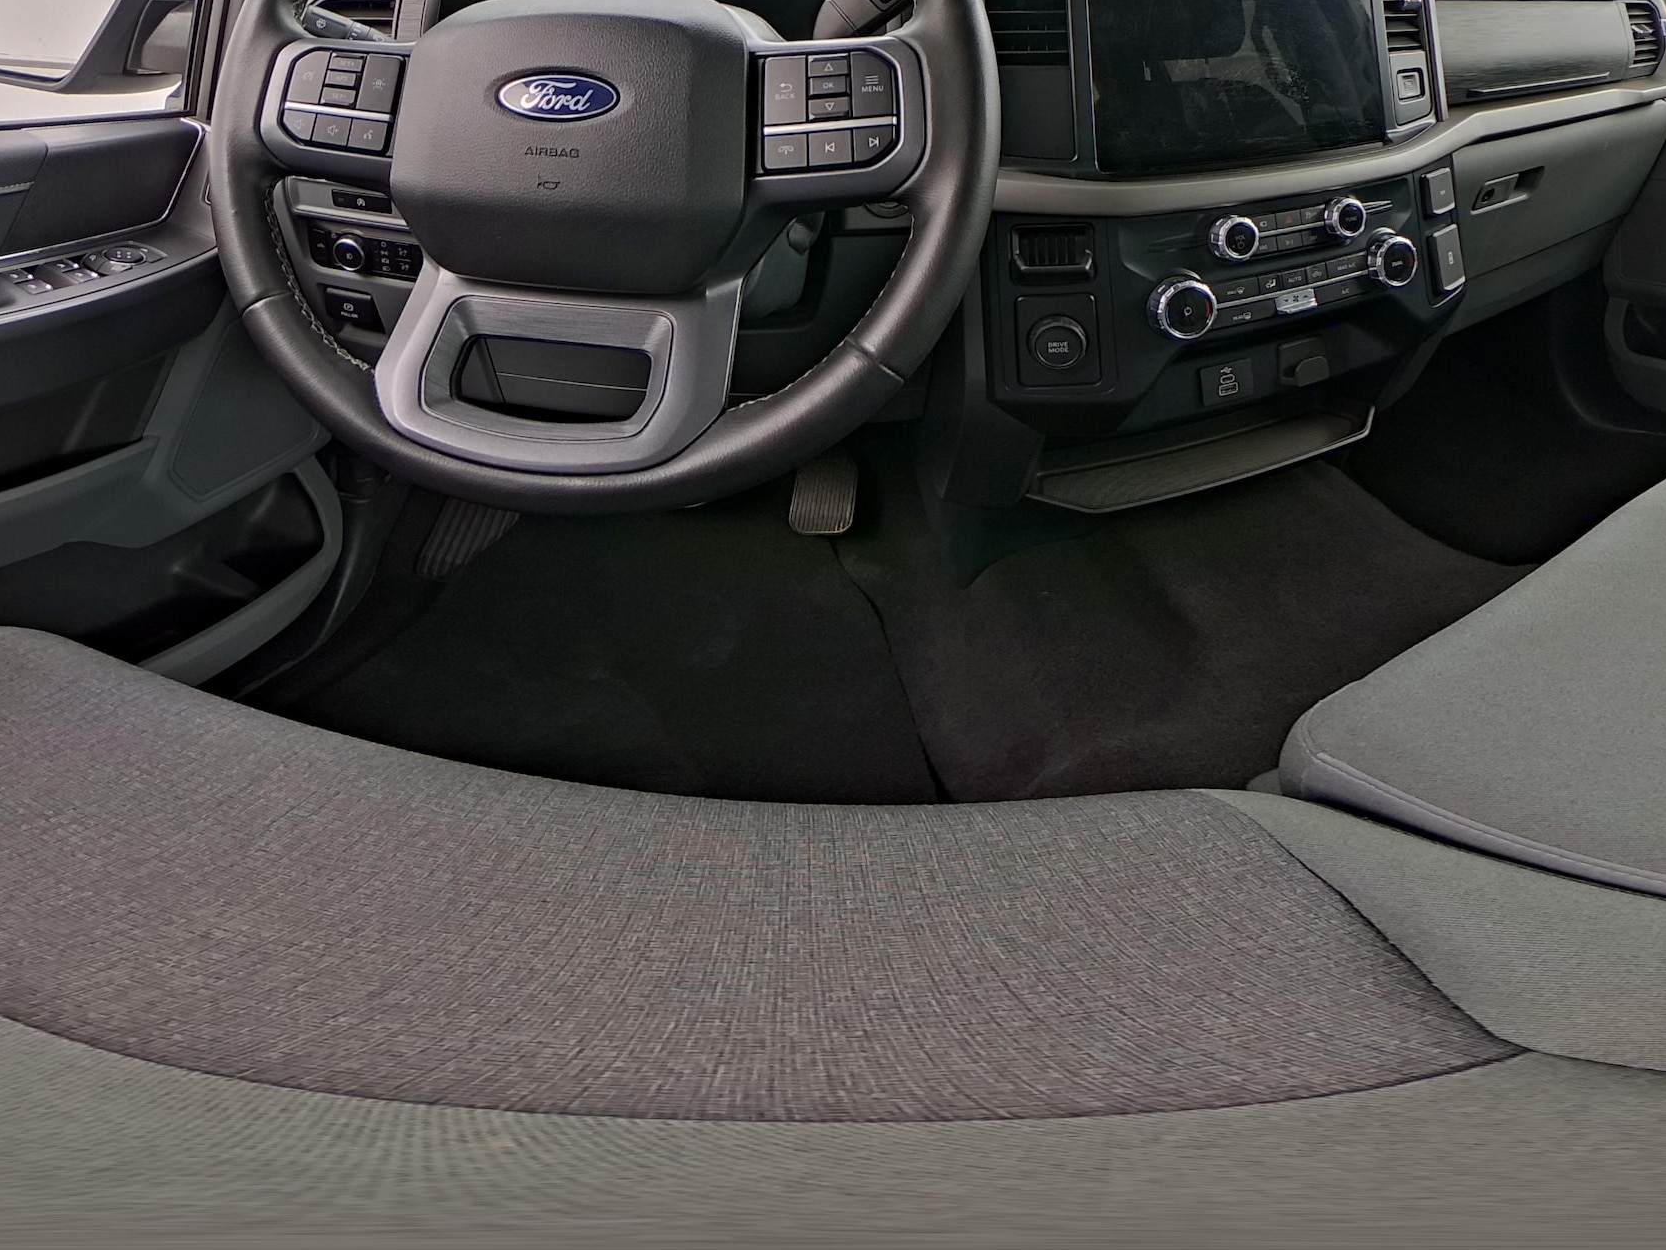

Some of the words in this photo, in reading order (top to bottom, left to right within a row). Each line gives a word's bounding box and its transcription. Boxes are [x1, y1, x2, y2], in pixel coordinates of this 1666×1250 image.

[861, 85, 884, 93] MENU
[520, 80, 595, 111] Ford
[524, 146, 580, 159] AIRBAG
[1287, 275, 1302, 283] AUTO
